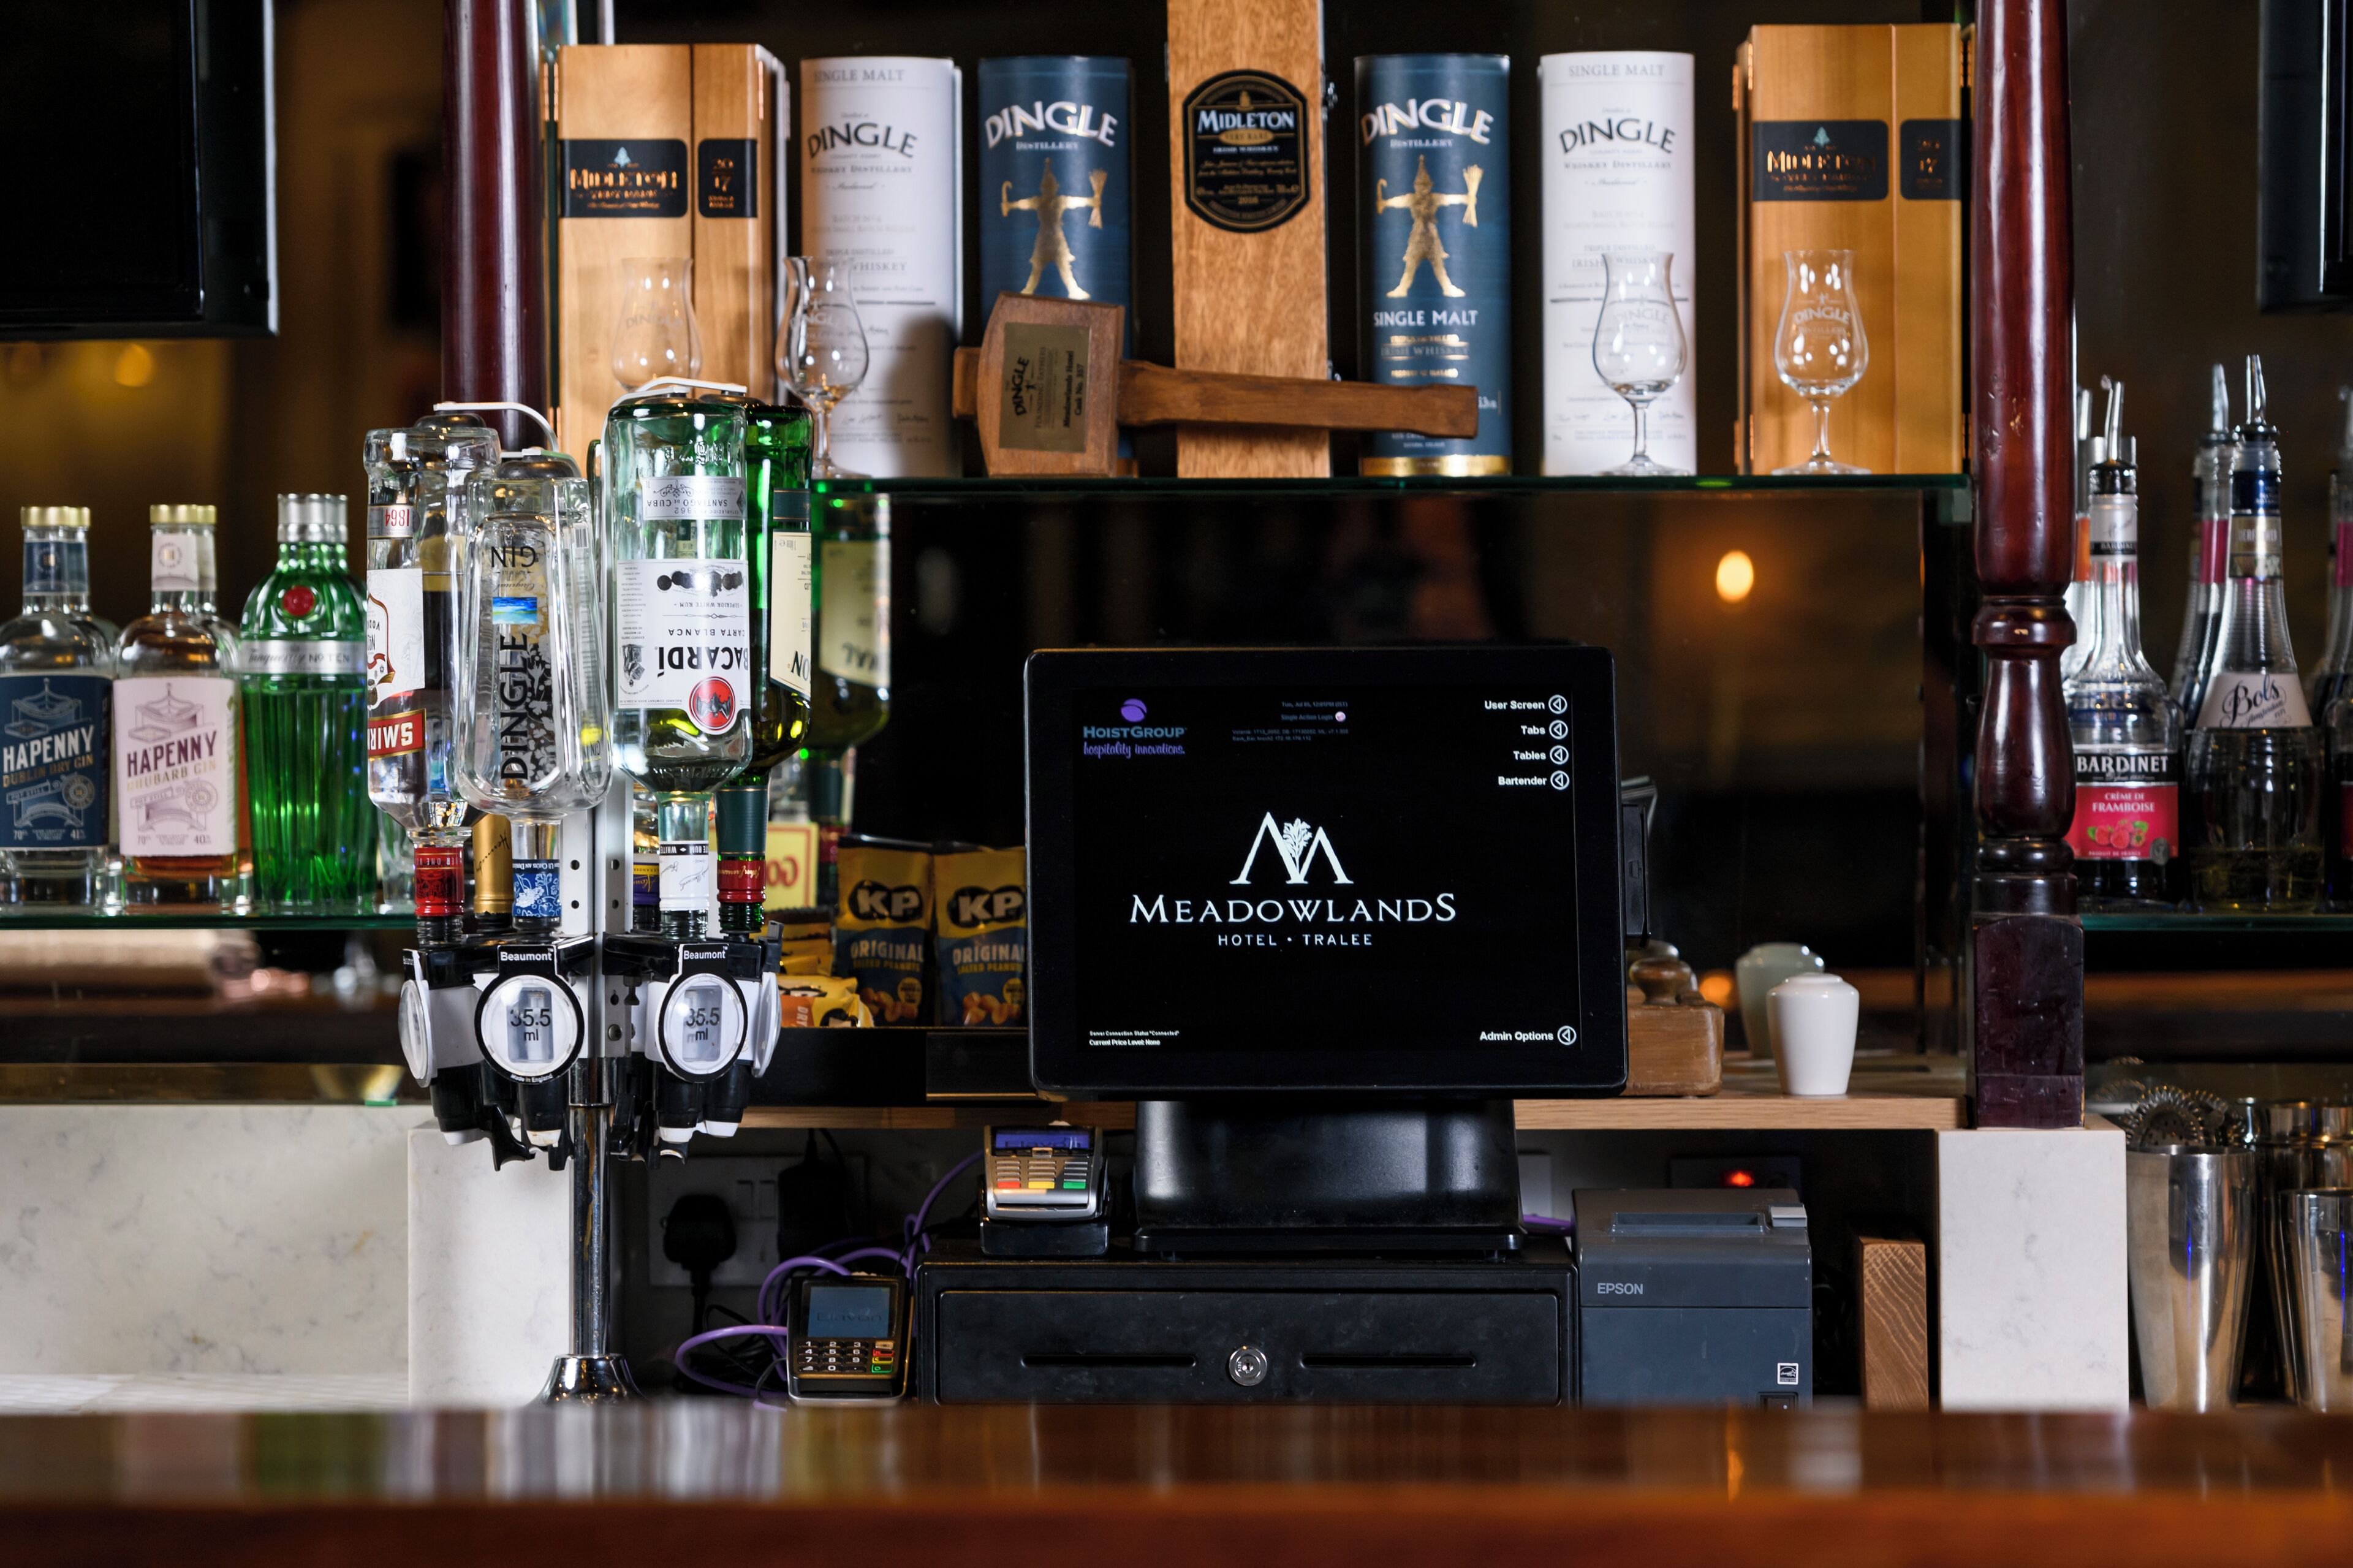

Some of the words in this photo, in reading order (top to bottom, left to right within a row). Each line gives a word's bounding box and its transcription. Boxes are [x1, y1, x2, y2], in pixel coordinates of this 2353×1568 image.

[863, 69, 905, 81] MALT
[1569, 65, 1620, 77] SINGLE
[1625, 64, 1665, 76] MALT
[984, 100, 1118, 150] DINGLE
[1197, 110, 1295, 133] MIDLETON
[1361, 98, 1494, 146] DINGLE
[808, 122, 918, 159] DINGLE
[1390, 139, 1453, 148] DISTILLERY
[1558, 117, 1676, 154] DINGLE
[1016, 141, 1079, 151] DISTILLERY
[1373, 310, 1425, 327] SINGLE
[1432, 309, 1479, 326] MALT
[1794, 308, 1851, 324] DINGLE
[1011, 357, 1030, 416] DINGLE
[385, 509, 409, 527] 1864
[491, 545, 536, 568] GIN
[493, 580, 535, 593] Original
[327, 653, 350, 663] TEN
[657, 646, 748, 678] BACARDÍ
[499, 632, 529, 779] DINGLE
[1484, 700, 1507, 710] User
[1510, 700, 1545, 710] Screen
[2221, 674, 2280, 727] Bols
[1520, 725, 1546, 735] Tabs
[1083, 741, 1131, 759] hospitality
[1135, 743, 1185, 756] innovations.
[1513, 751, 1547, 760] Tables
[2, 766, 46, 788] DUBLIN
[74, 754, 94, 768] GIN
[2077, 756, 2169, 773] BARDINET
[127, 766, 188, 792] RHUBARB
[194, 759, 216, 775] GIN
[1498, 776, 1547, 786] Bartender
[2104, 792, 2132, 801] CRÈME
[2091, 802, 2155, 812] FRAMBOISE
[857, 888, 920, 917] KP
[957, 890, 1024, 923] KP
[1129, 892, 1457, 924] MEADOWLANDS
[1218, 933, 1277, 946] HOTEL
[1303, 933, 1373, 946] TRALEE
[500, 951, 553, 961] Beaumont
[683, 950, 726, 960] Beaumont
[850, 939, 923, 963] ORIGINAL
[510, 1008, 551, 1028] 35.5
[686, 1007, 721, 1027] 35.5
[796, 1005, 809, 1027] DRY
[523, 1029, 539, 1042] ml
[695, 1028, 708, 1041] ml
[1479, 1031, 1512, 1041] Admin
[1514, 1031, 1554, 1043] Options
[531, 1074, 553, 1084] England
[1597, 1283, 1643, 1295] EPSON
